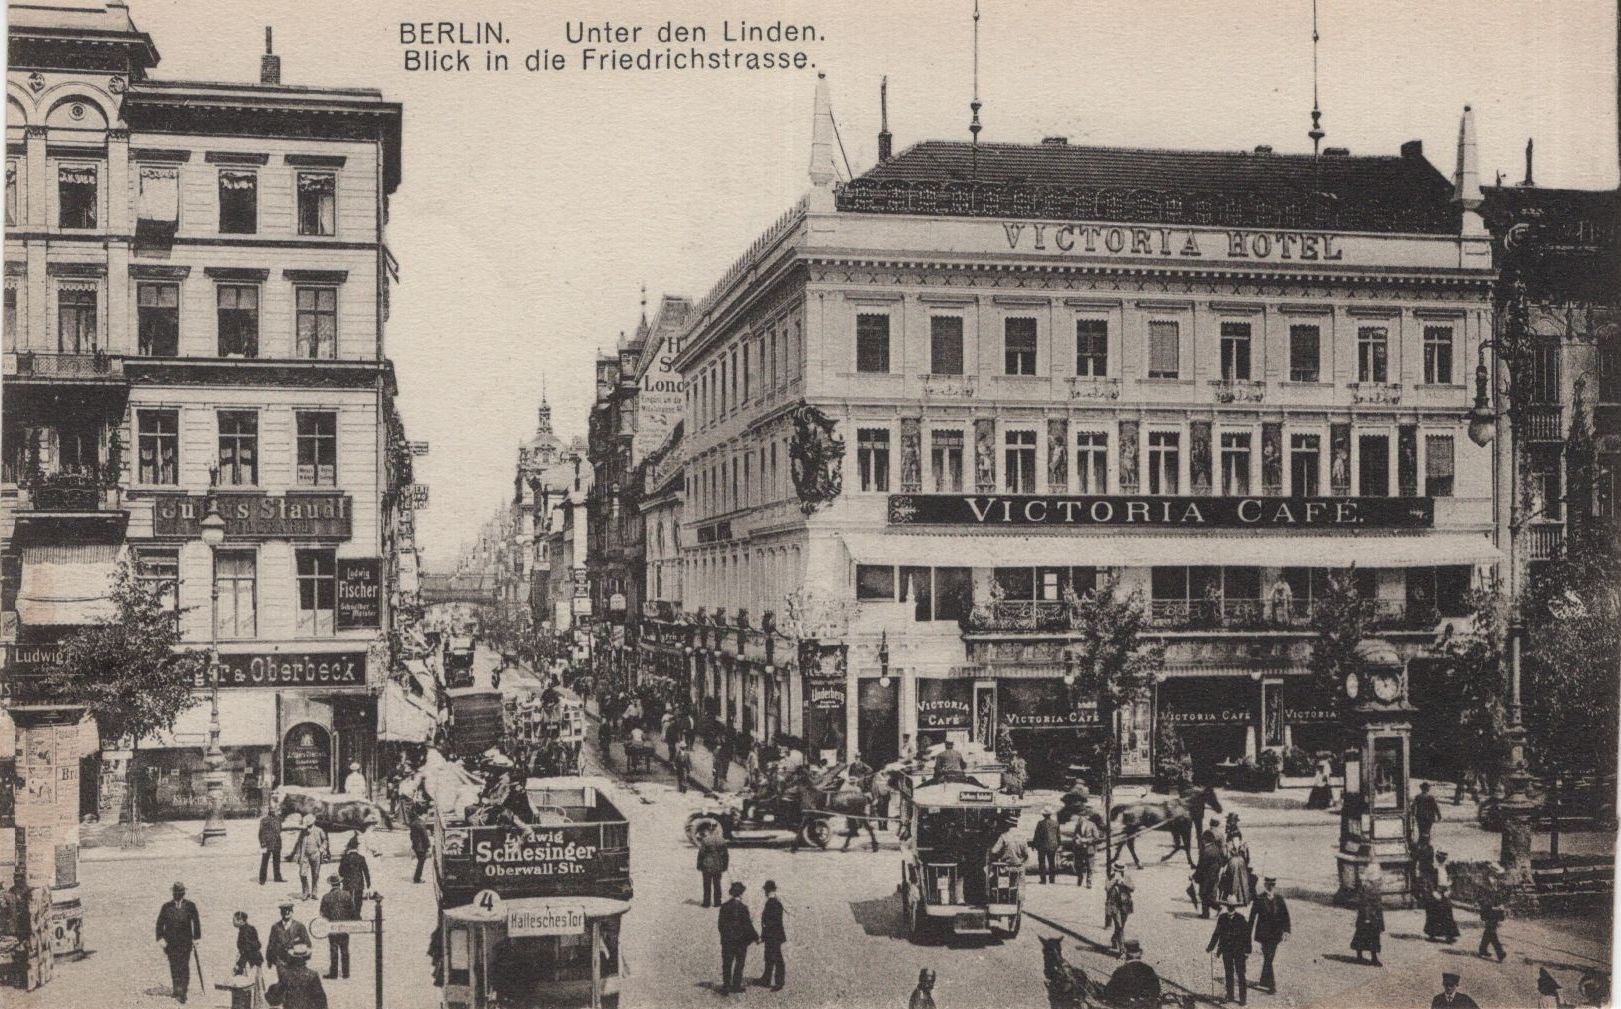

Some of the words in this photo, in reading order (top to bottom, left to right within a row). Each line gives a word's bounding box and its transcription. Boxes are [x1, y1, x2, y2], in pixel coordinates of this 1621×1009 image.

[1003, 223, 1202, 257] VICTORIA
[1227, 231, 1343, 260] HOTEL
[964, 498, 1206, 522] VICTORIA
[339, 580, 378, 599] Fischer
[15, 647, 63, 665] Ludwig
[250, 656, 356, 683] Oberbeck
[917, 700, 970, 714] VICTORIA
[475, 840, 597, 863] Schlesinger
[480, 892, 494, 912] 4
[511, 911, 567, 929] Hallesches
[567, 910, 582, 927] Tor
